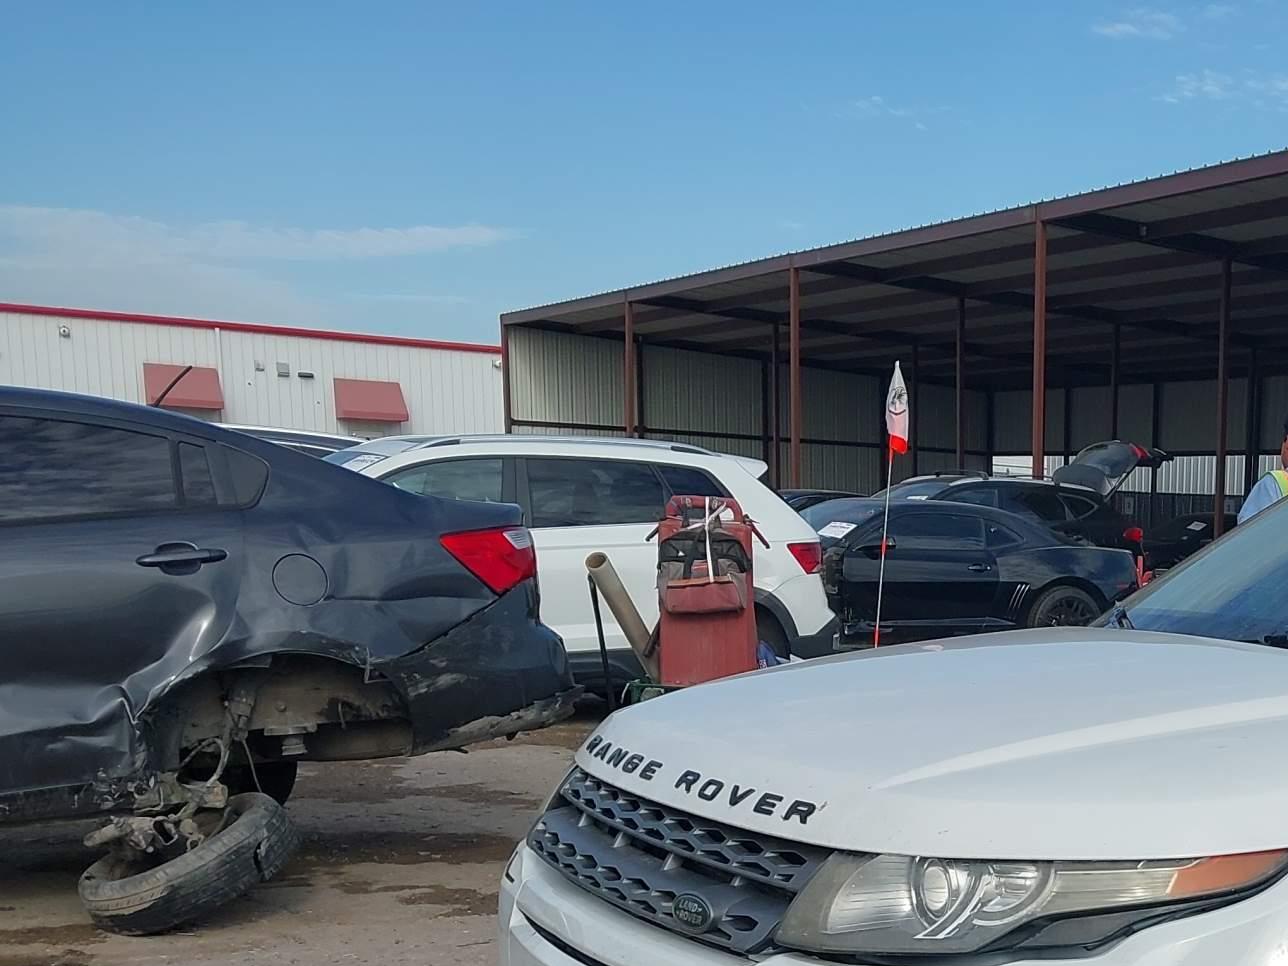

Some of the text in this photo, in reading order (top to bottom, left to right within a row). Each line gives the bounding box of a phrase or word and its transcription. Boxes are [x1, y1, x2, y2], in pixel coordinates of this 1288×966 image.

[585, 734, 818, 825] RANGE ROVER
[679, 898, 699, 913] LAND
[679, 909, 703, 926] ROVER
